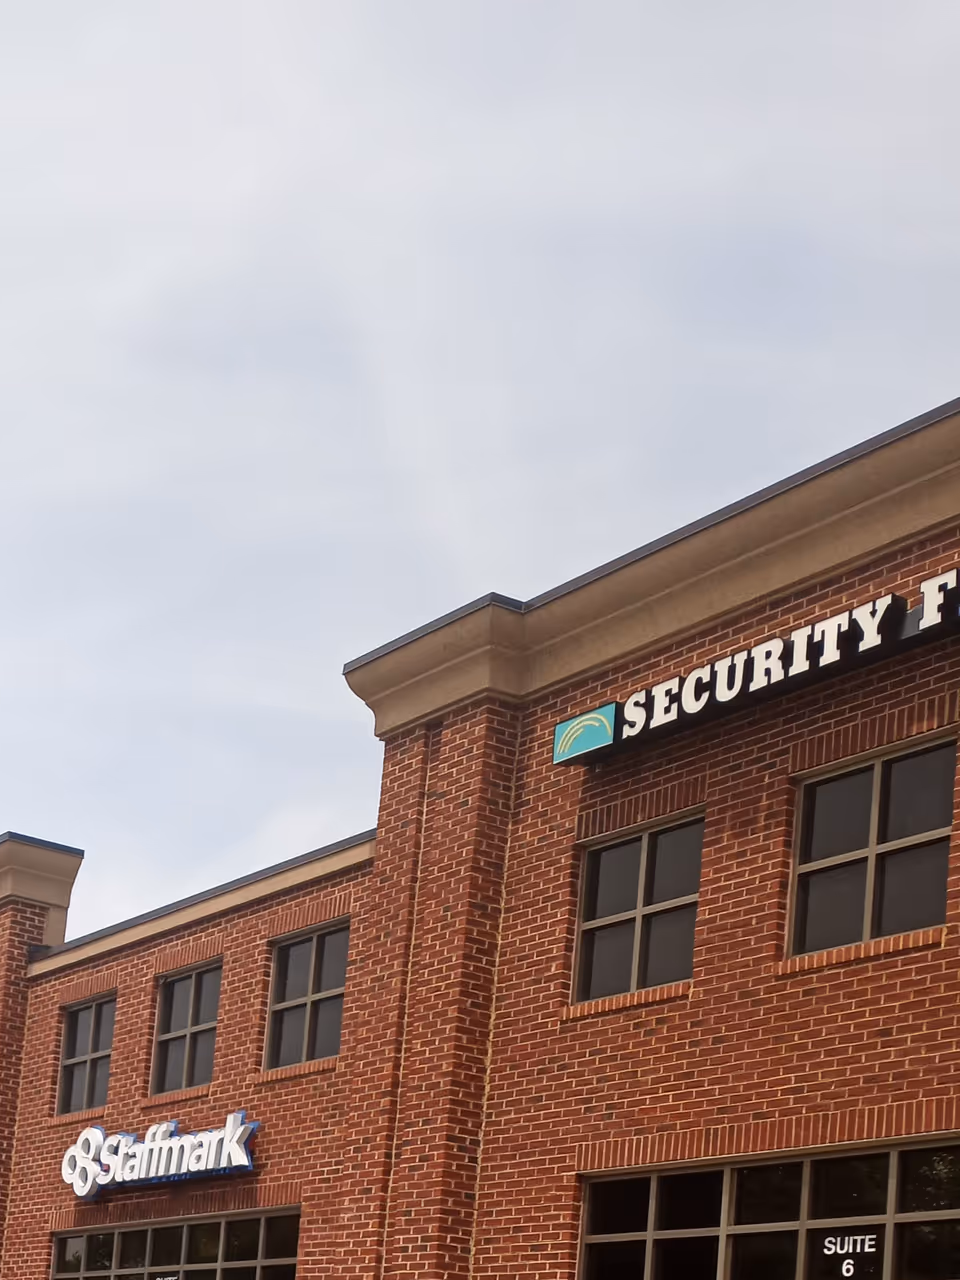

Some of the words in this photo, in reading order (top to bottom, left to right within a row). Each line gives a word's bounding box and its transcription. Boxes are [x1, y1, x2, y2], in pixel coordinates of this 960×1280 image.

[622, 593, 893, 740] SECURITY
[919, 567, 958, 631] F
[95, 1113, 254, 1185] Staffmark
[823, 1234, 877, 1255] SUITE
[841, 1258, 855, 1278] 6
